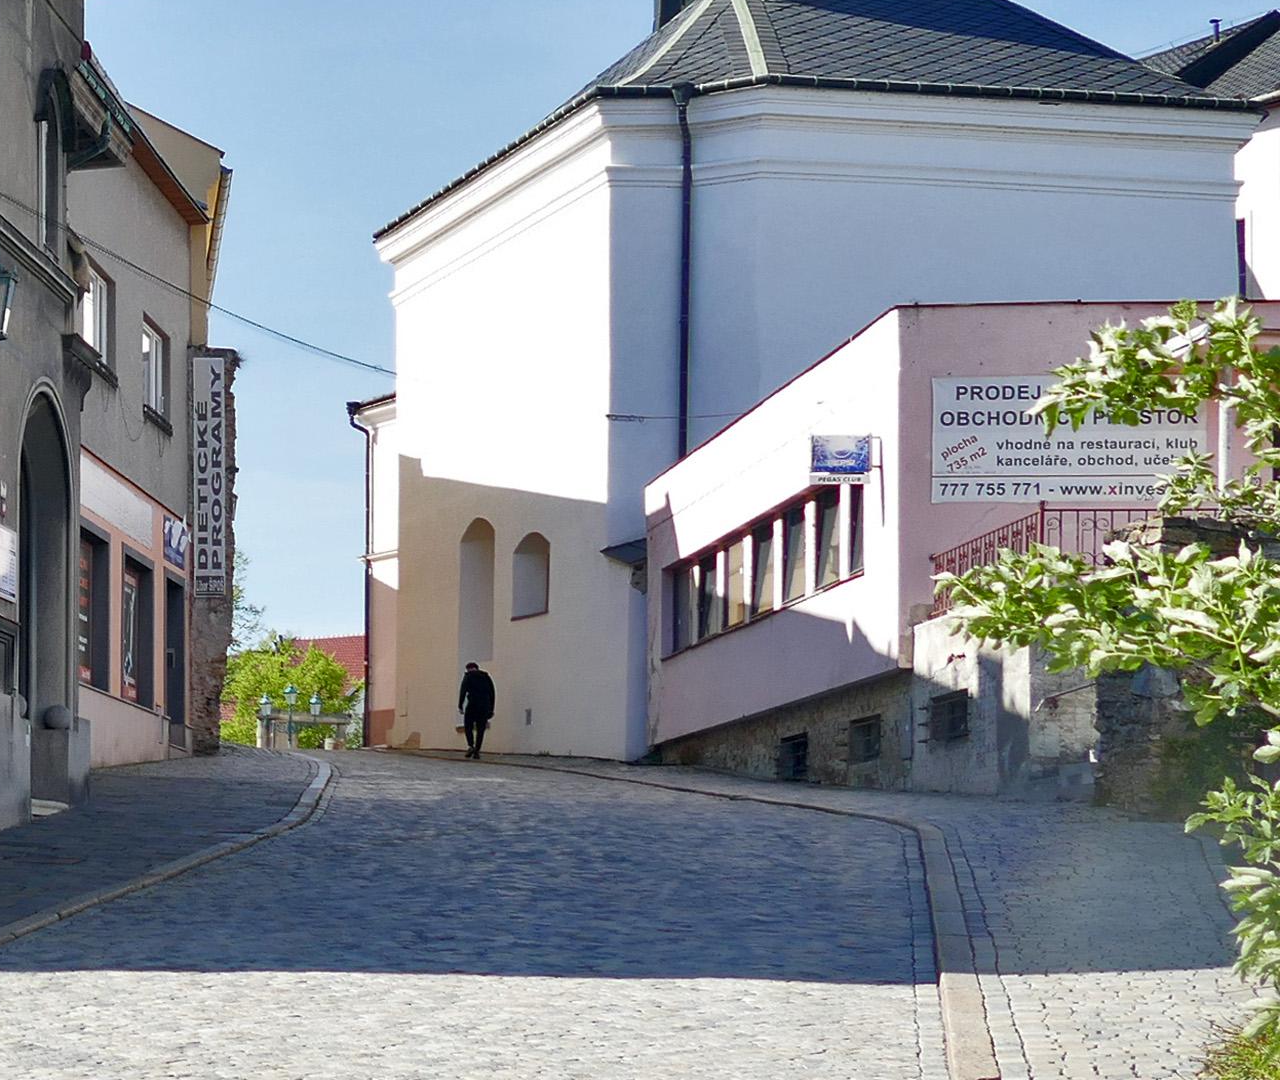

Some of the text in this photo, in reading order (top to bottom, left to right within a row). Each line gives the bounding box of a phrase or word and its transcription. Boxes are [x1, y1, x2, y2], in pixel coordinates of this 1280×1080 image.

[955, 385, 1041, 401] PRODEJ
[940, 434, 979, 461] plocha
[1056, 440, 1075, 450] na
[1080, 438, 1160, 451] restaurací,
[1165, 437, 1198, 450] klub
[210, 365, 223, 570] PROGRAMY
[947, 456, 969, 472] 735
[969, 446, 988, 462] m2
[996, 455, 1073, 467] kanceláře,
[1077, 454, 1138, 467] obchod,
[195, 400, 209, 570] DIETICKÉ
[940, 483, 969, 496] 777
[975, 483, 1006, 496] 755
[1011, 482, 1041, 496] 771
